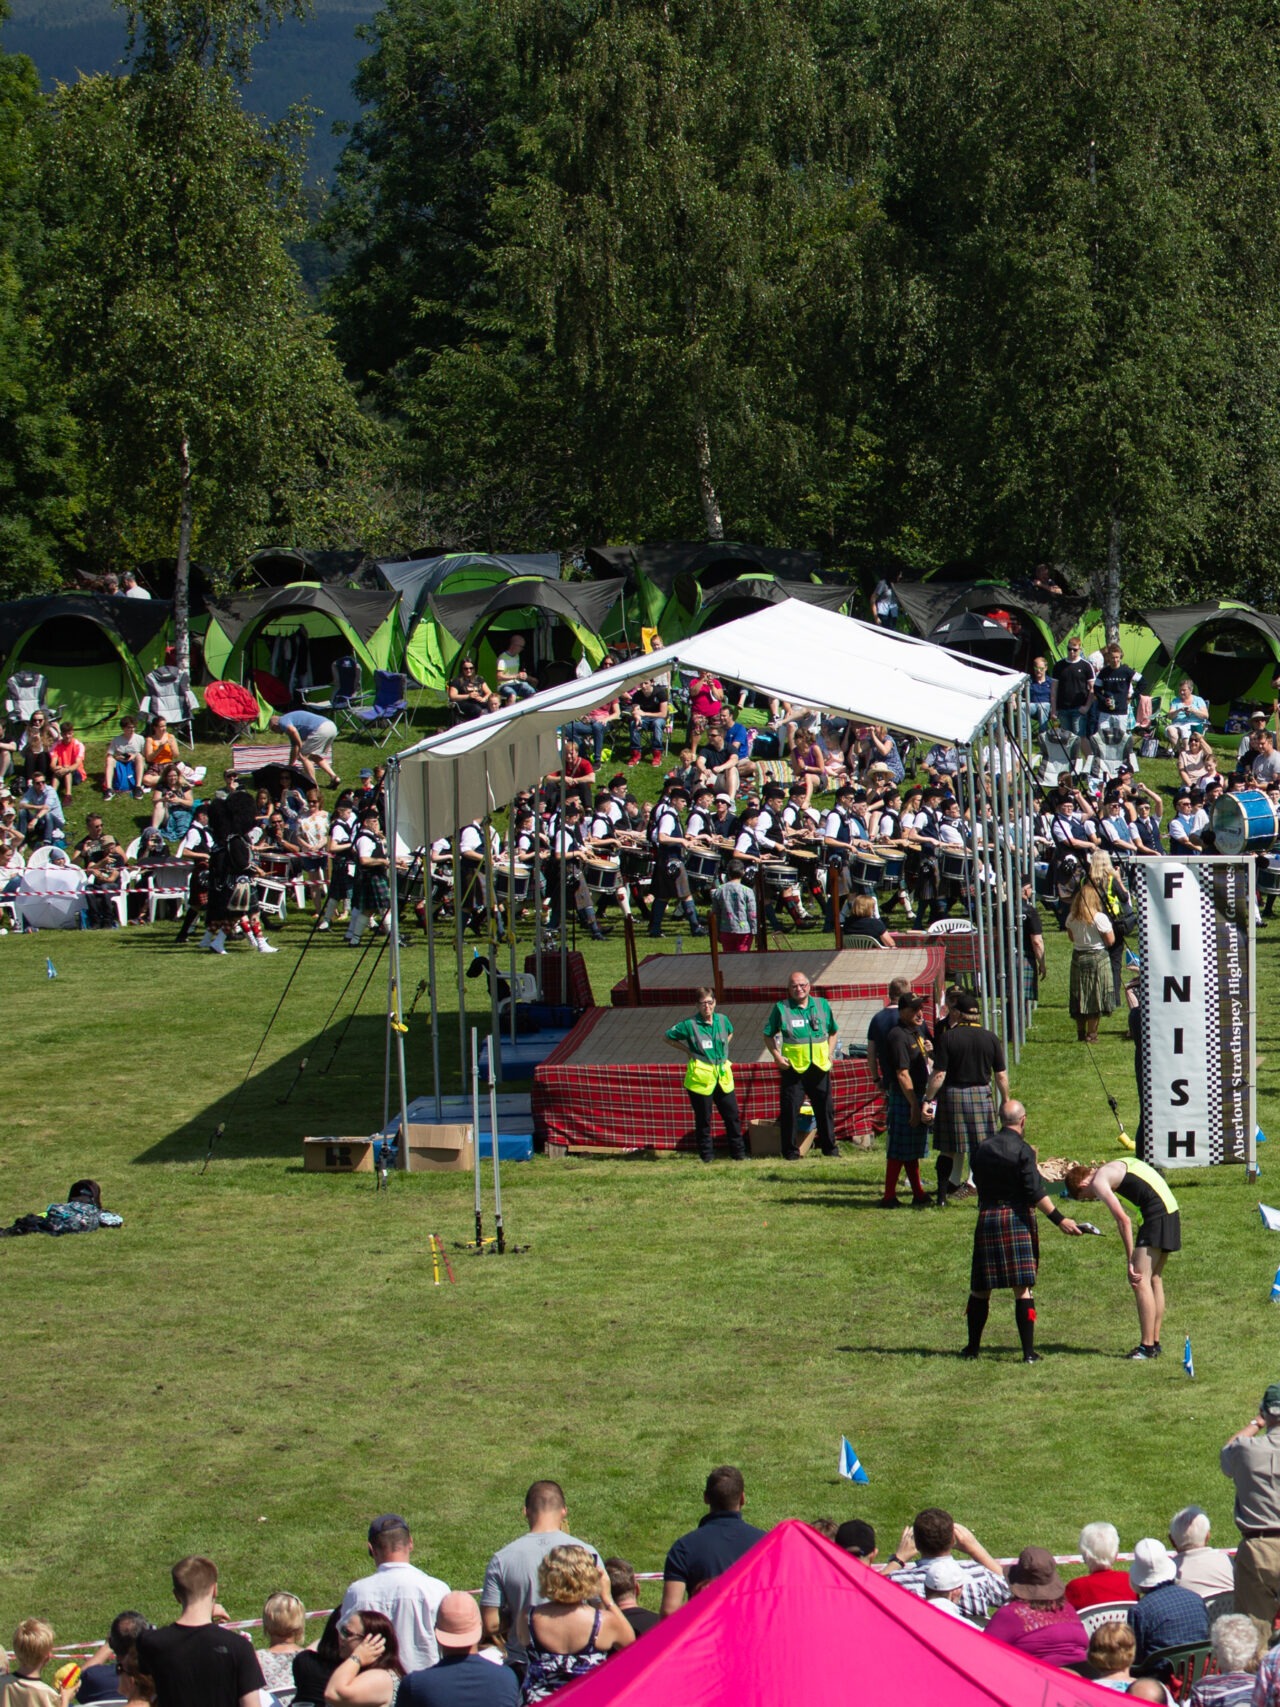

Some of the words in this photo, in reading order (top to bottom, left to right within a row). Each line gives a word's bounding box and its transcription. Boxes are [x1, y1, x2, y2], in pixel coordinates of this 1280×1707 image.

[1225, 864, 1236, 919] Games
[1226, 922, 1242, 996] Highland
[1163, 872, 1195, 1158] FINISH
[1229, 998, 1244, 1087] Strathspey
[1232, 1090, 1246, 1160] Aberlour
